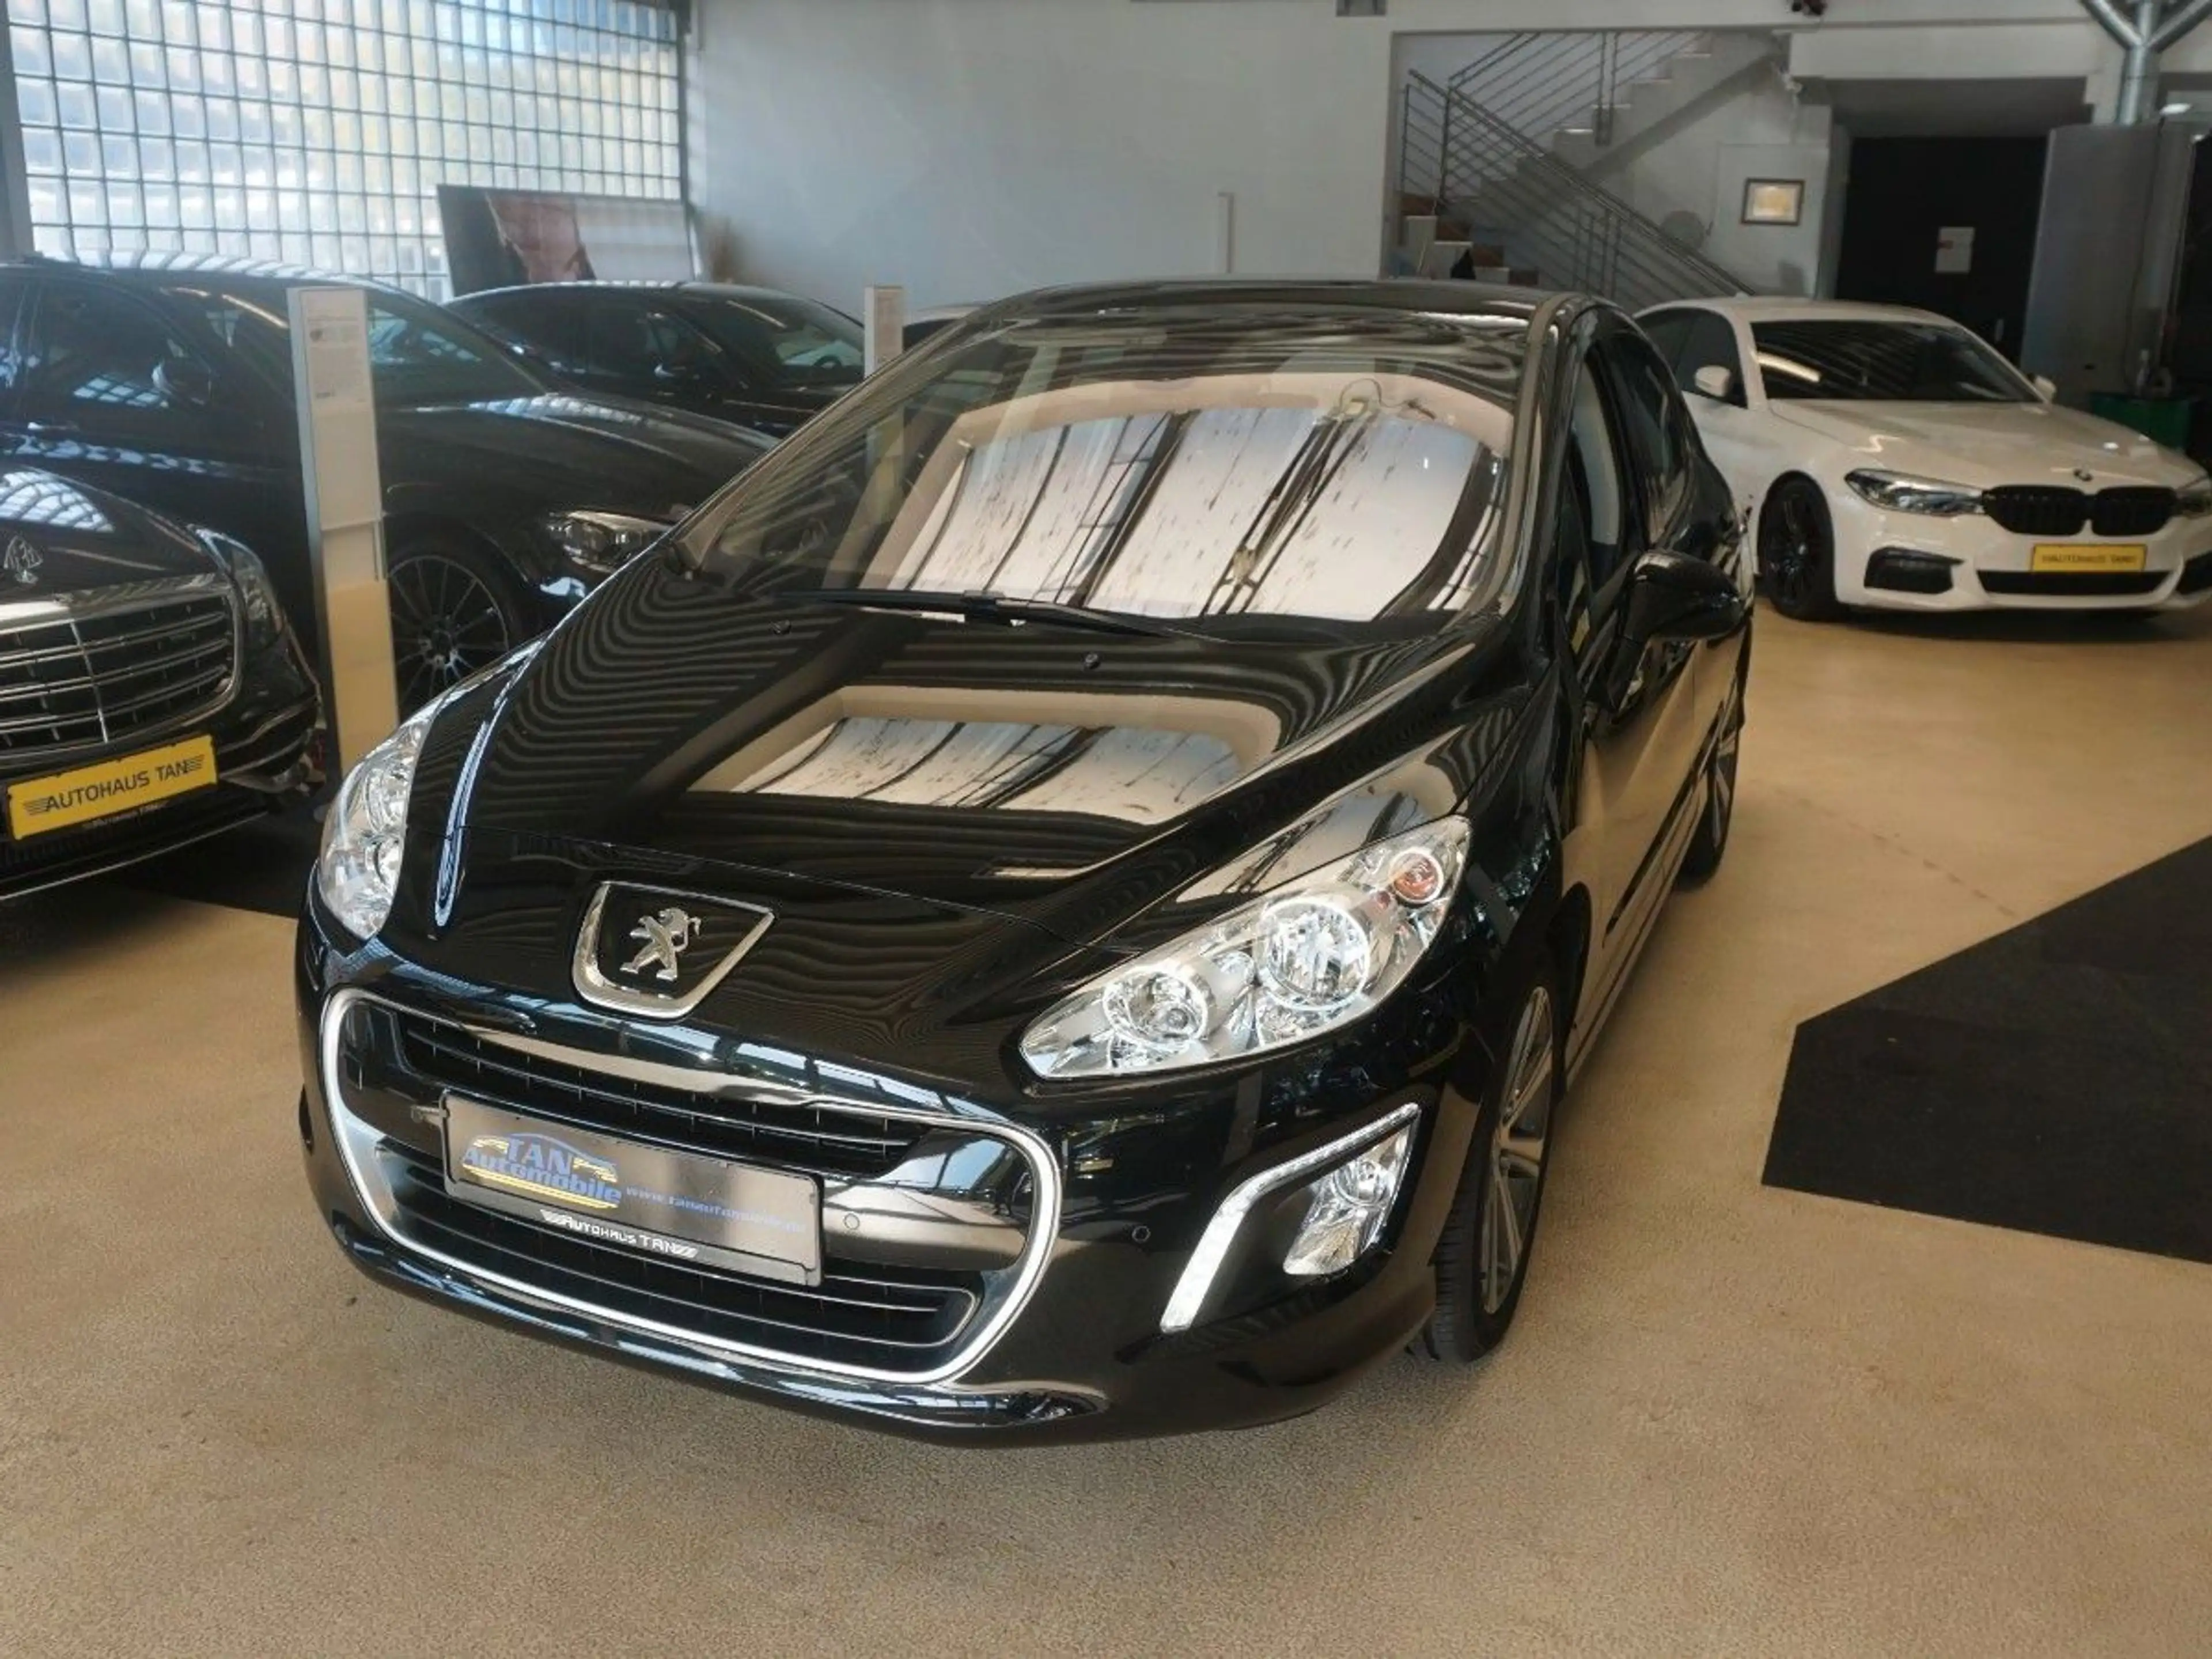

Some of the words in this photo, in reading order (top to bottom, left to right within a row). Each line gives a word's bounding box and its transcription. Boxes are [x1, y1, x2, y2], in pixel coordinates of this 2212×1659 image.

[46, 770, 150, 812] AUTOHAUS
[155, 759, 189, 783] TAN
[464, 1146, 622, 1205] Automobile
[508, 1137, 573, 1176] TAN
[562, 1215, 637, 1245] AUTOHAUS
[639, 1234, 676, 1255] TAN
